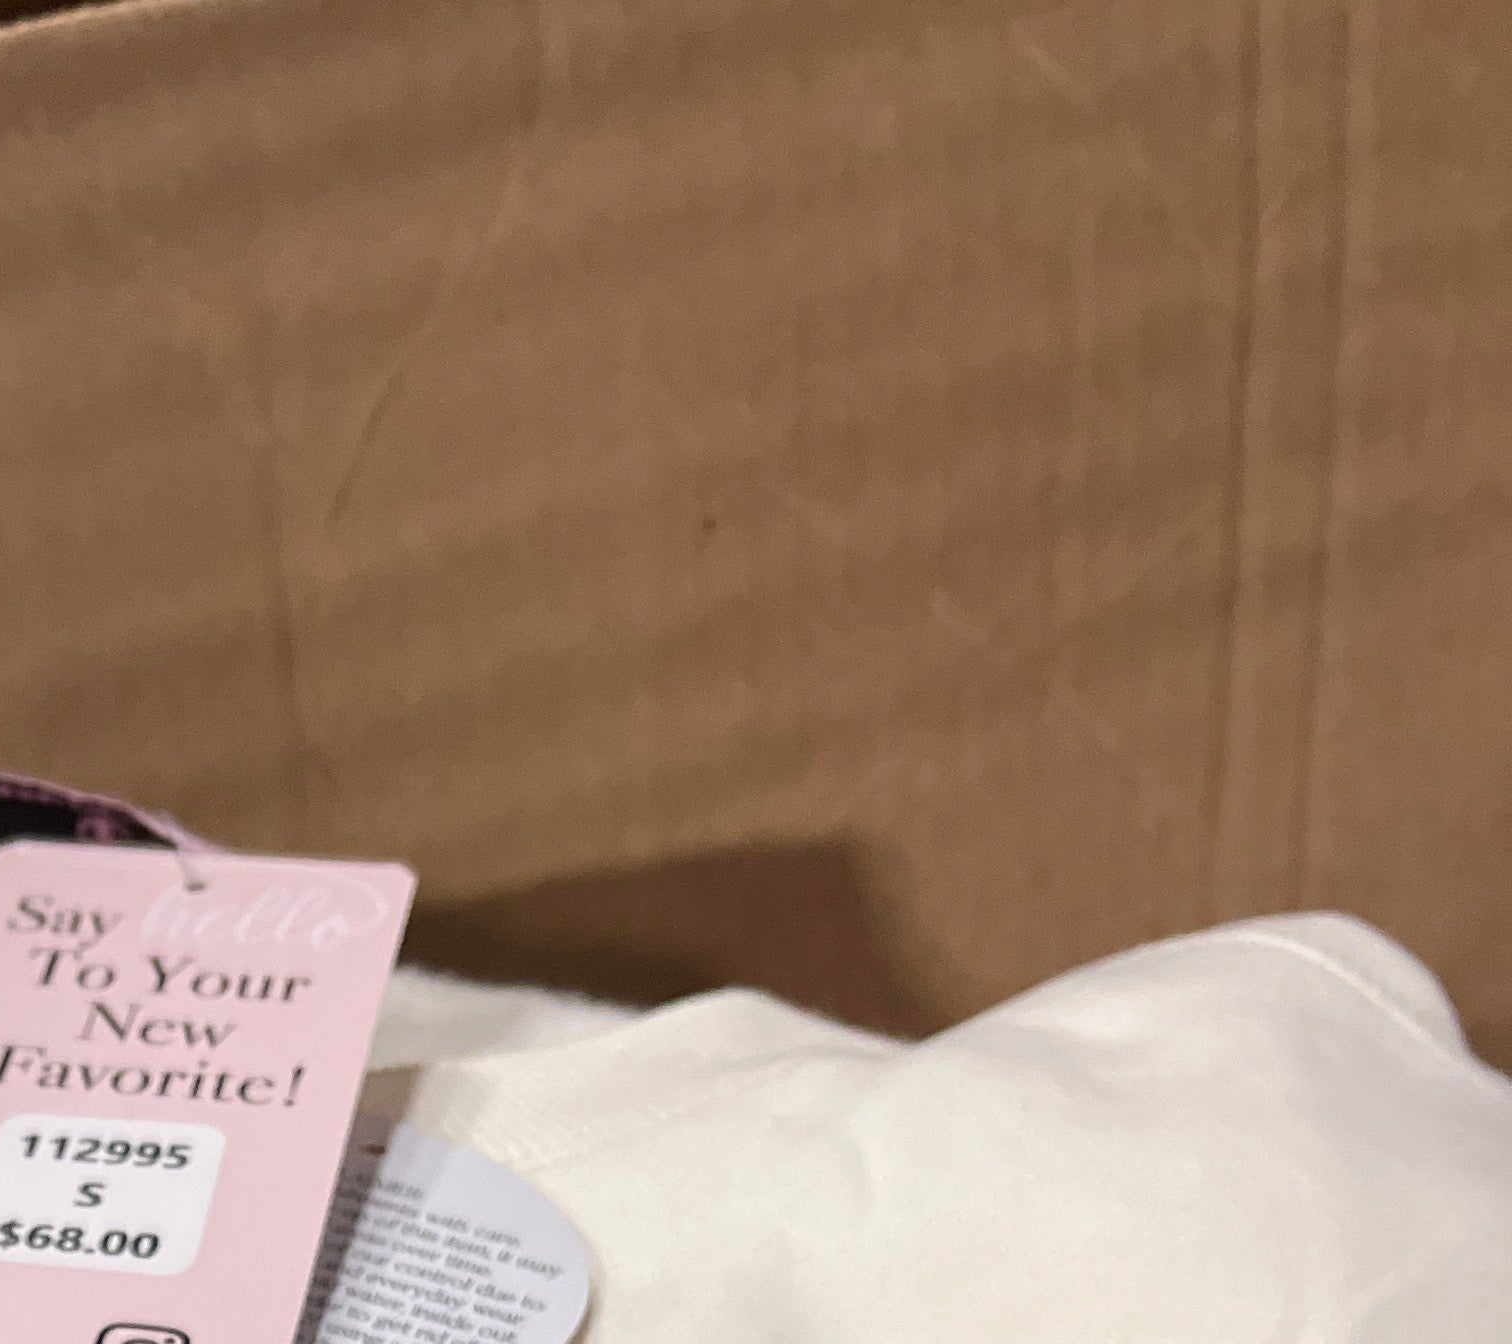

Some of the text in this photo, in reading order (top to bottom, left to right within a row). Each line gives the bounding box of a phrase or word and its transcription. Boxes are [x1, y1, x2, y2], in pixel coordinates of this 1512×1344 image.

[6, 893, 122, 956] Say
[29, 946, 312, 1001] To Your
[76, 999, 238, 1050] New
[20, 1133, 190, 1170] 112995
[74, 1181, 107, 1208] S
